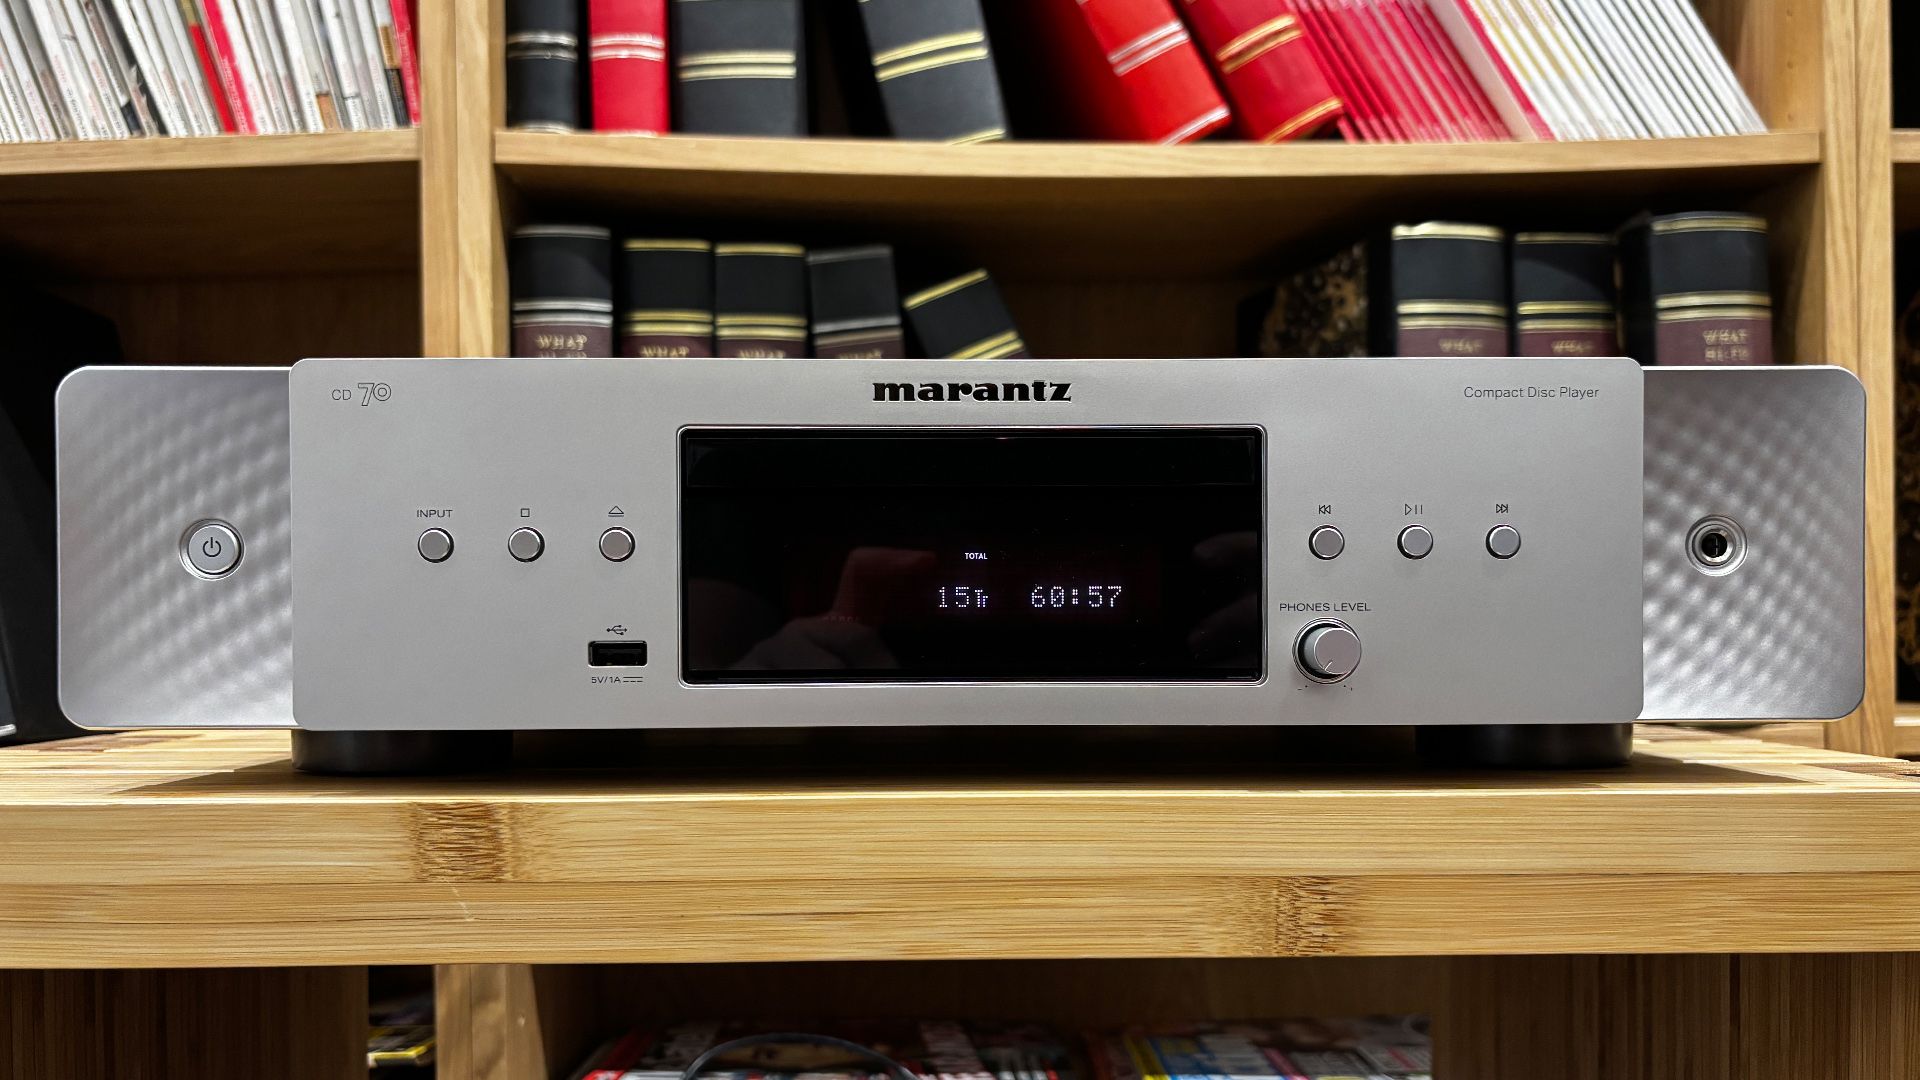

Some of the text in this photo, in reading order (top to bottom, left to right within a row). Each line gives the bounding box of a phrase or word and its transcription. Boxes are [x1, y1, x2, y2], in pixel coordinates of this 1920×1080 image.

[332, 382, 392, 407] CD 70
[872, 379, 1073, 403] marantz
[1463, 386, 1600, 400] Compact Disc Player
[416, 509, 454, 518] INPUT
[964, 552, 988, 560] TOTAL
[1031, 585, 1122, 607] 60:57
[1279, 602, 1372, 612] PHONES LEVEL
[591, 676, 622, 684] 5V/1A
